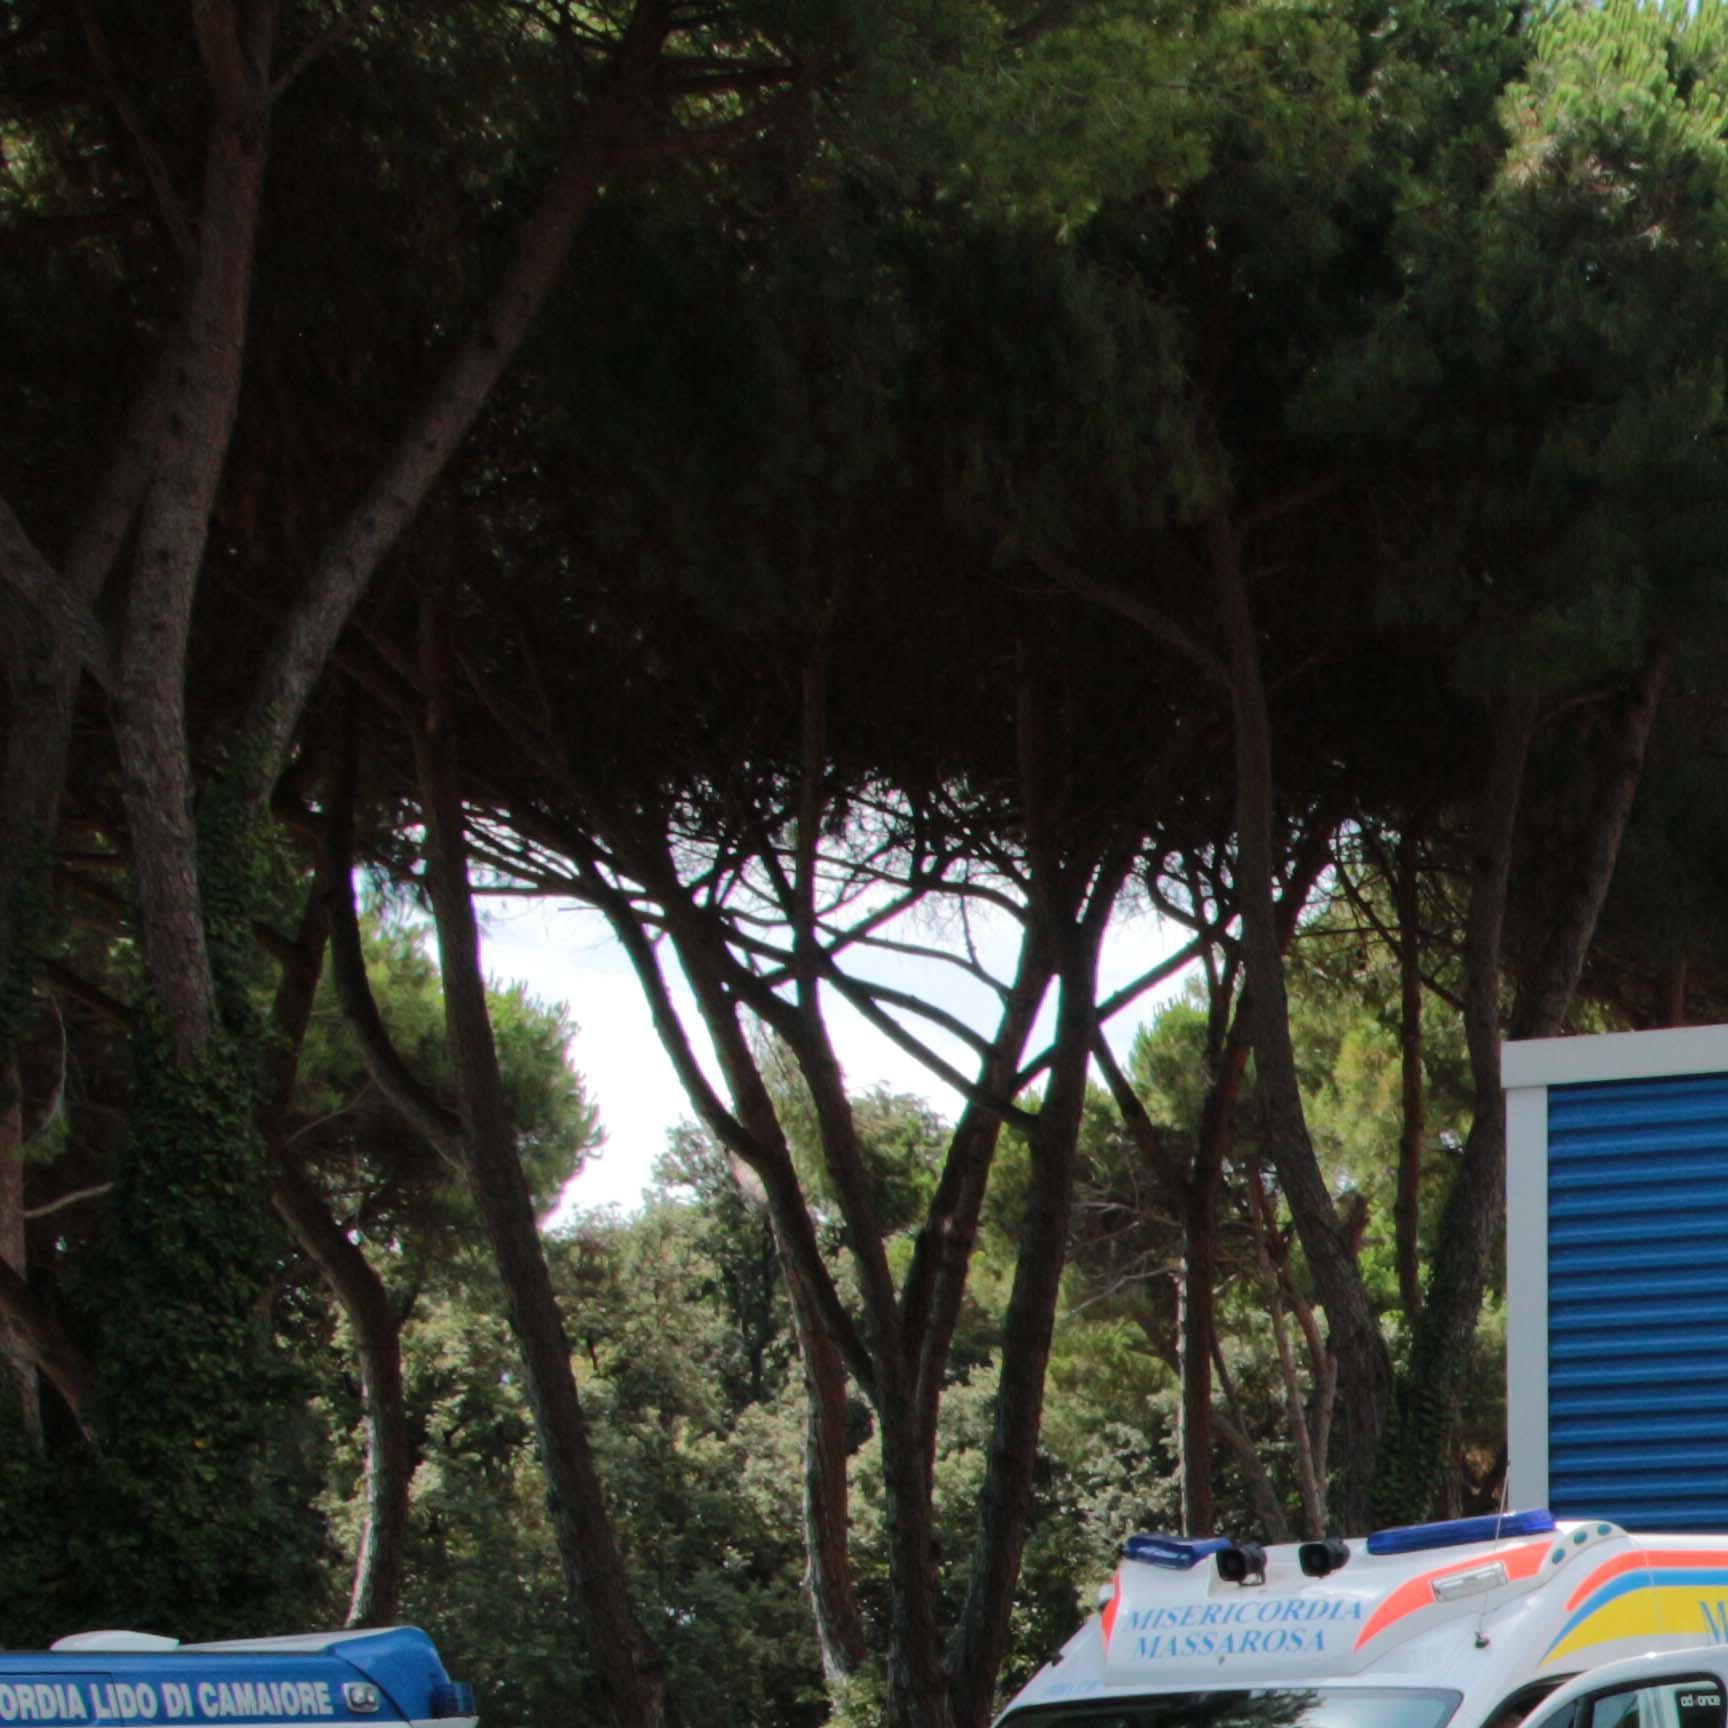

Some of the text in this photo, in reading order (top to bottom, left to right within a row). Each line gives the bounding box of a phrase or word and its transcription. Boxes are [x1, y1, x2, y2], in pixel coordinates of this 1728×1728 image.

[1128, 1599, 1363, 1632] MISERICORDIA
[1133, 1627, 1326, 1660] MASSAROSA
[90, 1682, 158, 1720] LIDO
[162, 1682, 194, 1718] DI
[198, 1681, 334, 1717] CAMAIORE
